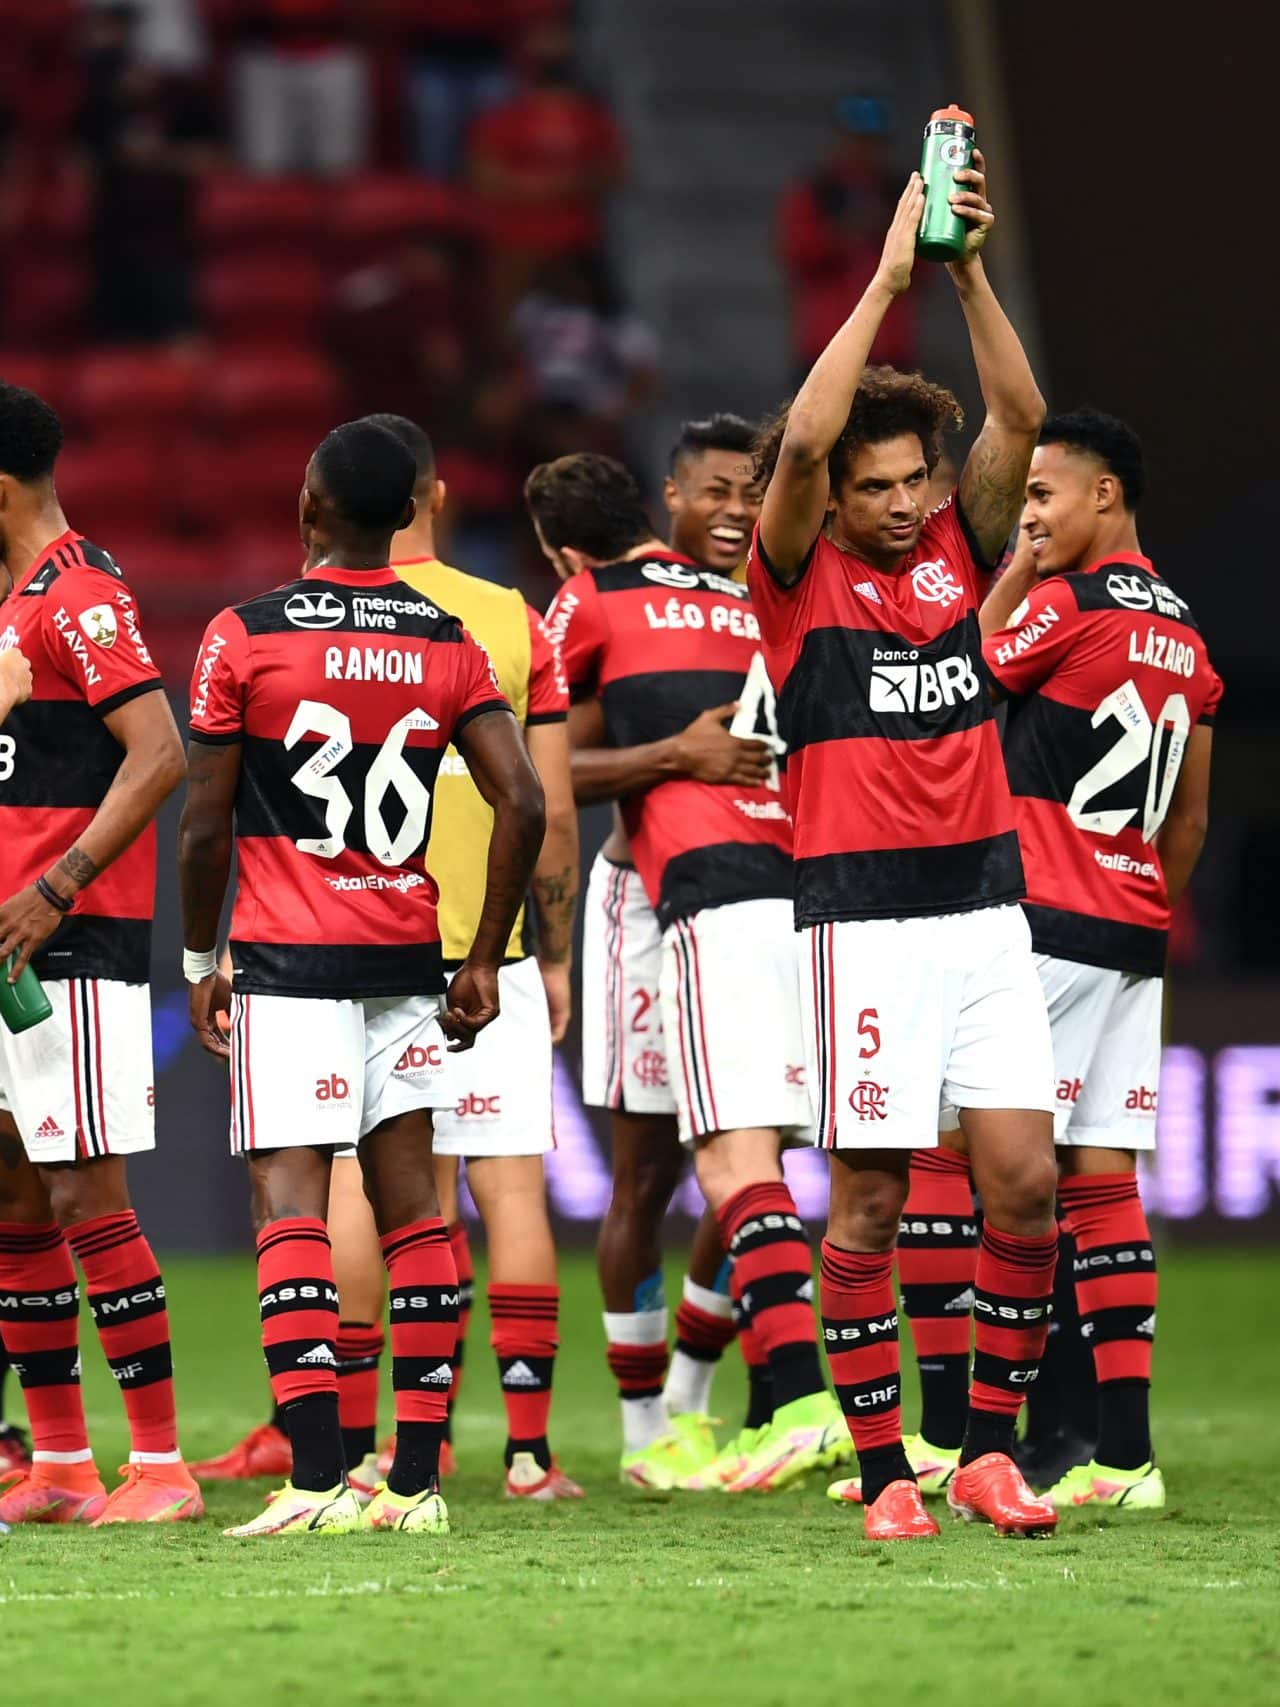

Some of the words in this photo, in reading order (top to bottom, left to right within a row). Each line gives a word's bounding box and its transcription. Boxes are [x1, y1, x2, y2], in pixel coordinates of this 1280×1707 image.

[353, 595, 438, 620] mercado
[354, 610, 396, 629] livre
[644, 597, 705, 630] LÉO
[117, 591, 152, 665] HAVAN
[994, 604, 1060, 666] HAVAN
[52, 607, 102, 687] HAVAN
[325, 647, 422, 684] RAMON
[873, 648, 919, 661] banco
[1128, 625, 1195, 678] LÁZARO
[192, 632, 227, 718] HAVAN
[322, 741, 344, 763] TIM
[1066, 678, 1191, 845] 20
[284, 699, 439, 867] 36
[858, 1008, 880, 1059] 5
[315, 1073, 349, 1101] ab
[455, 1092, 501, 1116] abc
[854, 1385, 897, 1408] CRF
